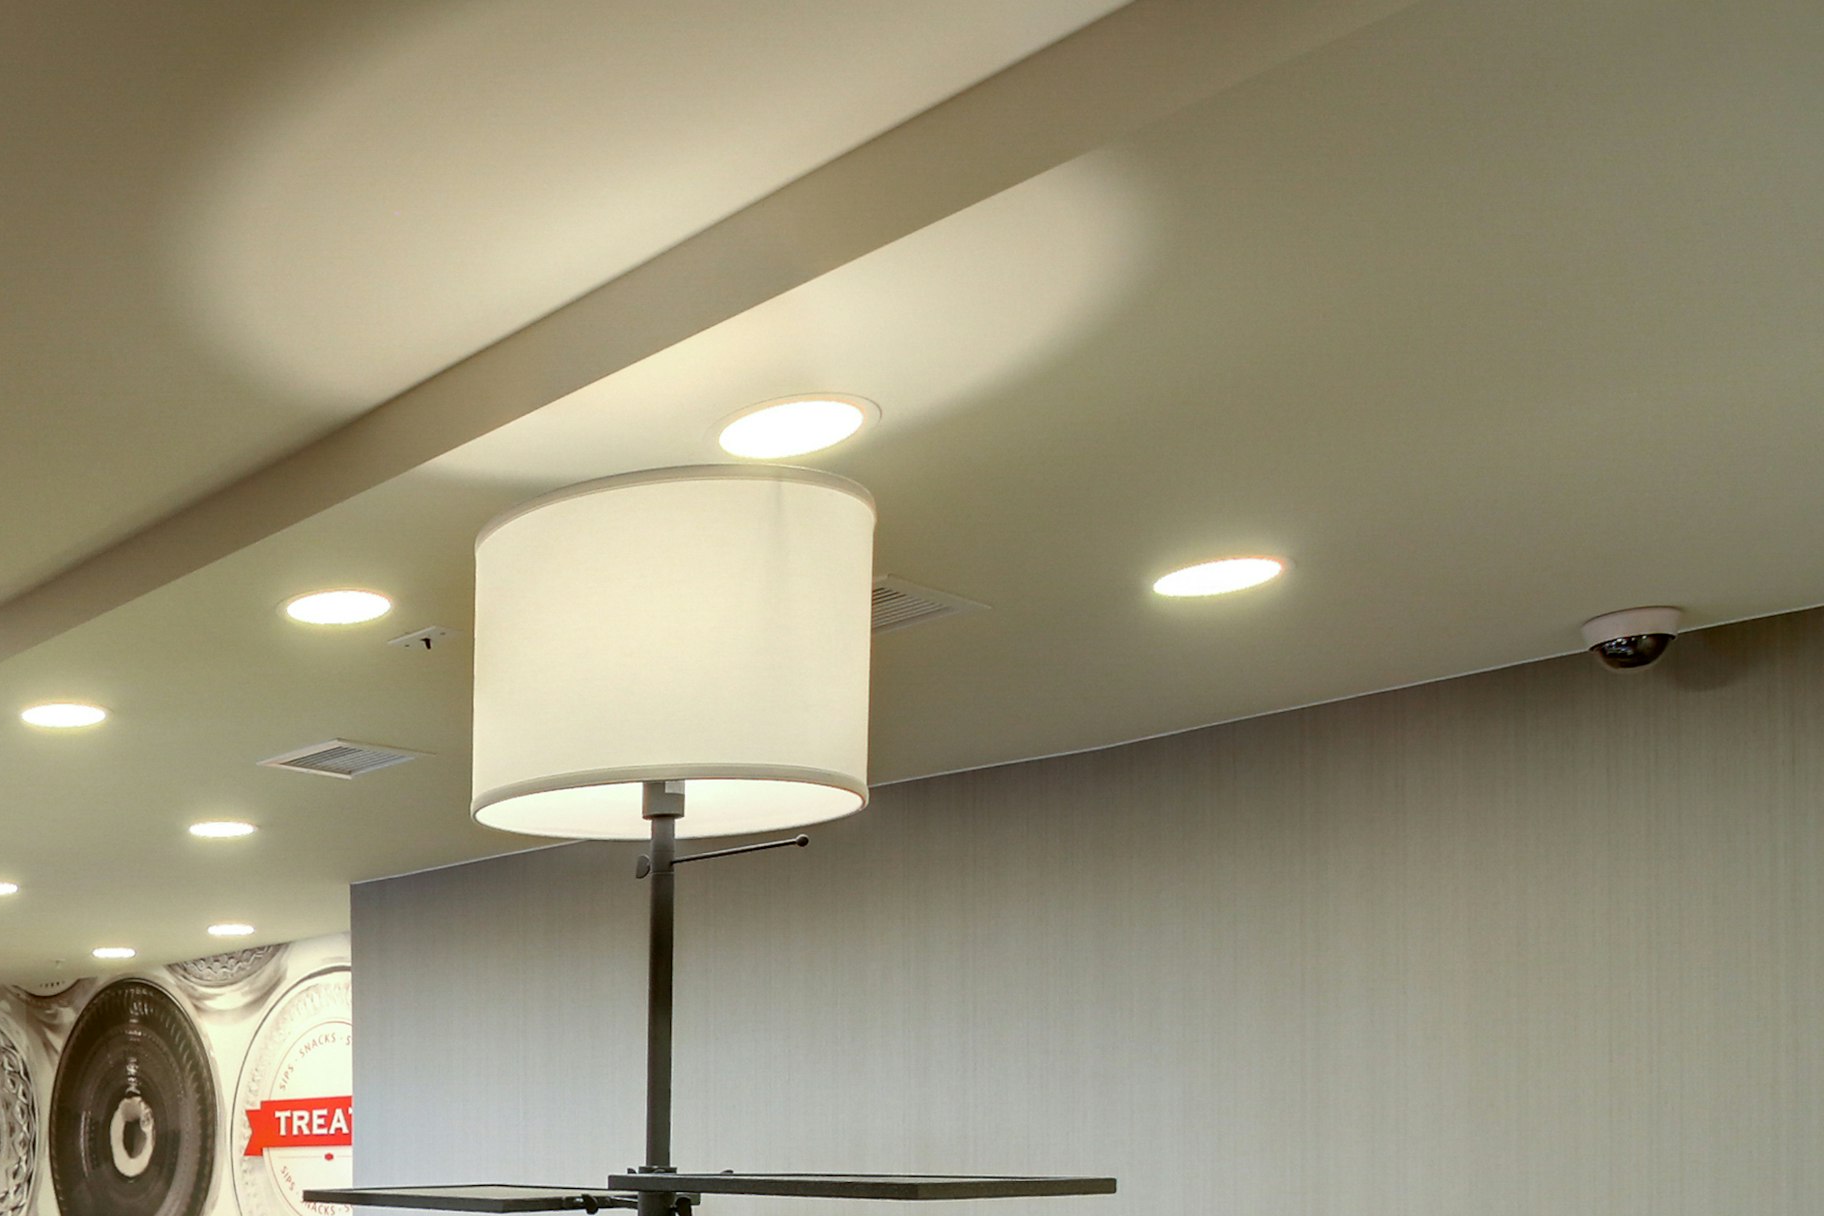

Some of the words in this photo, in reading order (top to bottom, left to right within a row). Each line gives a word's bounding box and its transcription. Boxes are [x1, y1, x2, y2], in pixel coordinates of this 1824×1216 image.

[279, 1065, 294, 1090] SIPS
[299, 1032, 337, 1058] SNACKS
[274, 1108, 352, 1136] TREA
[281, 1166, 295, 1191] SIPS
